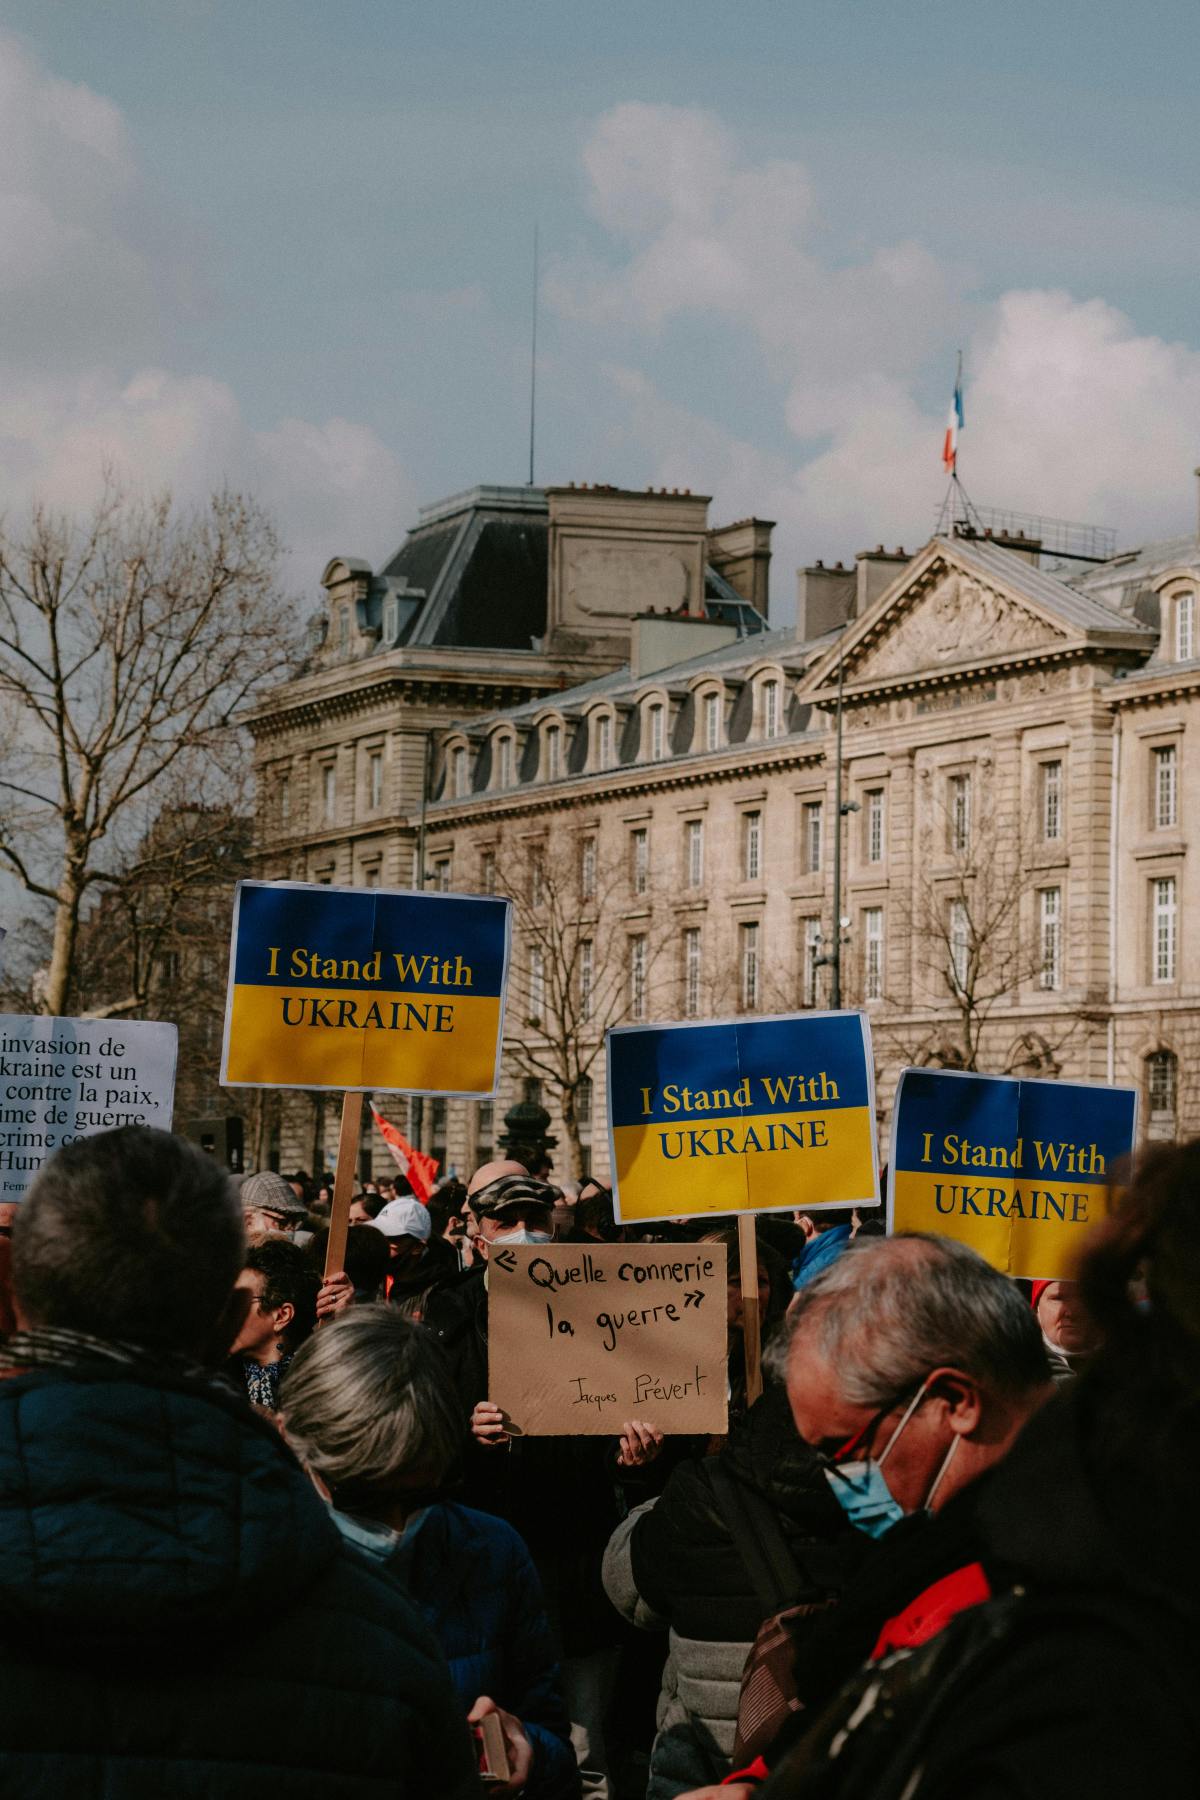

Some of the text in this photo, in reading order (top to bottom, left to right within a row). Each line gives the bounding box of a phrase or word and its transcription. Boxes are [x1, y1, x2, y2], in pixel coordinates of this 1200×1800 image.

[266, 947, 473, 986] I Stand With
[279, 997, 454, 1033] UKRAINE
[2, 1032, 126, 1057] invasion de
[71, 1063, 103, 1079] est
[110, 1066, 137, 1081] un
[5, 1082, 159, 1109] contre la paix,
[639, 1071, 841, 1115] I Stand With
[43, 1105, 68, 1125] de
[657, 1120, 829, 1160] UKRAINE
[920, 1133, 1107, 1175] I Stand With
[933, 1184, 1090, 1223] UKRAINE
[527, 1253, 608, 1293] Quelle
[617, 1255, 715, 1284] connerie
[546, 1302, 574, 1339] la
[568, 1377, 617, 1412] Jacques
